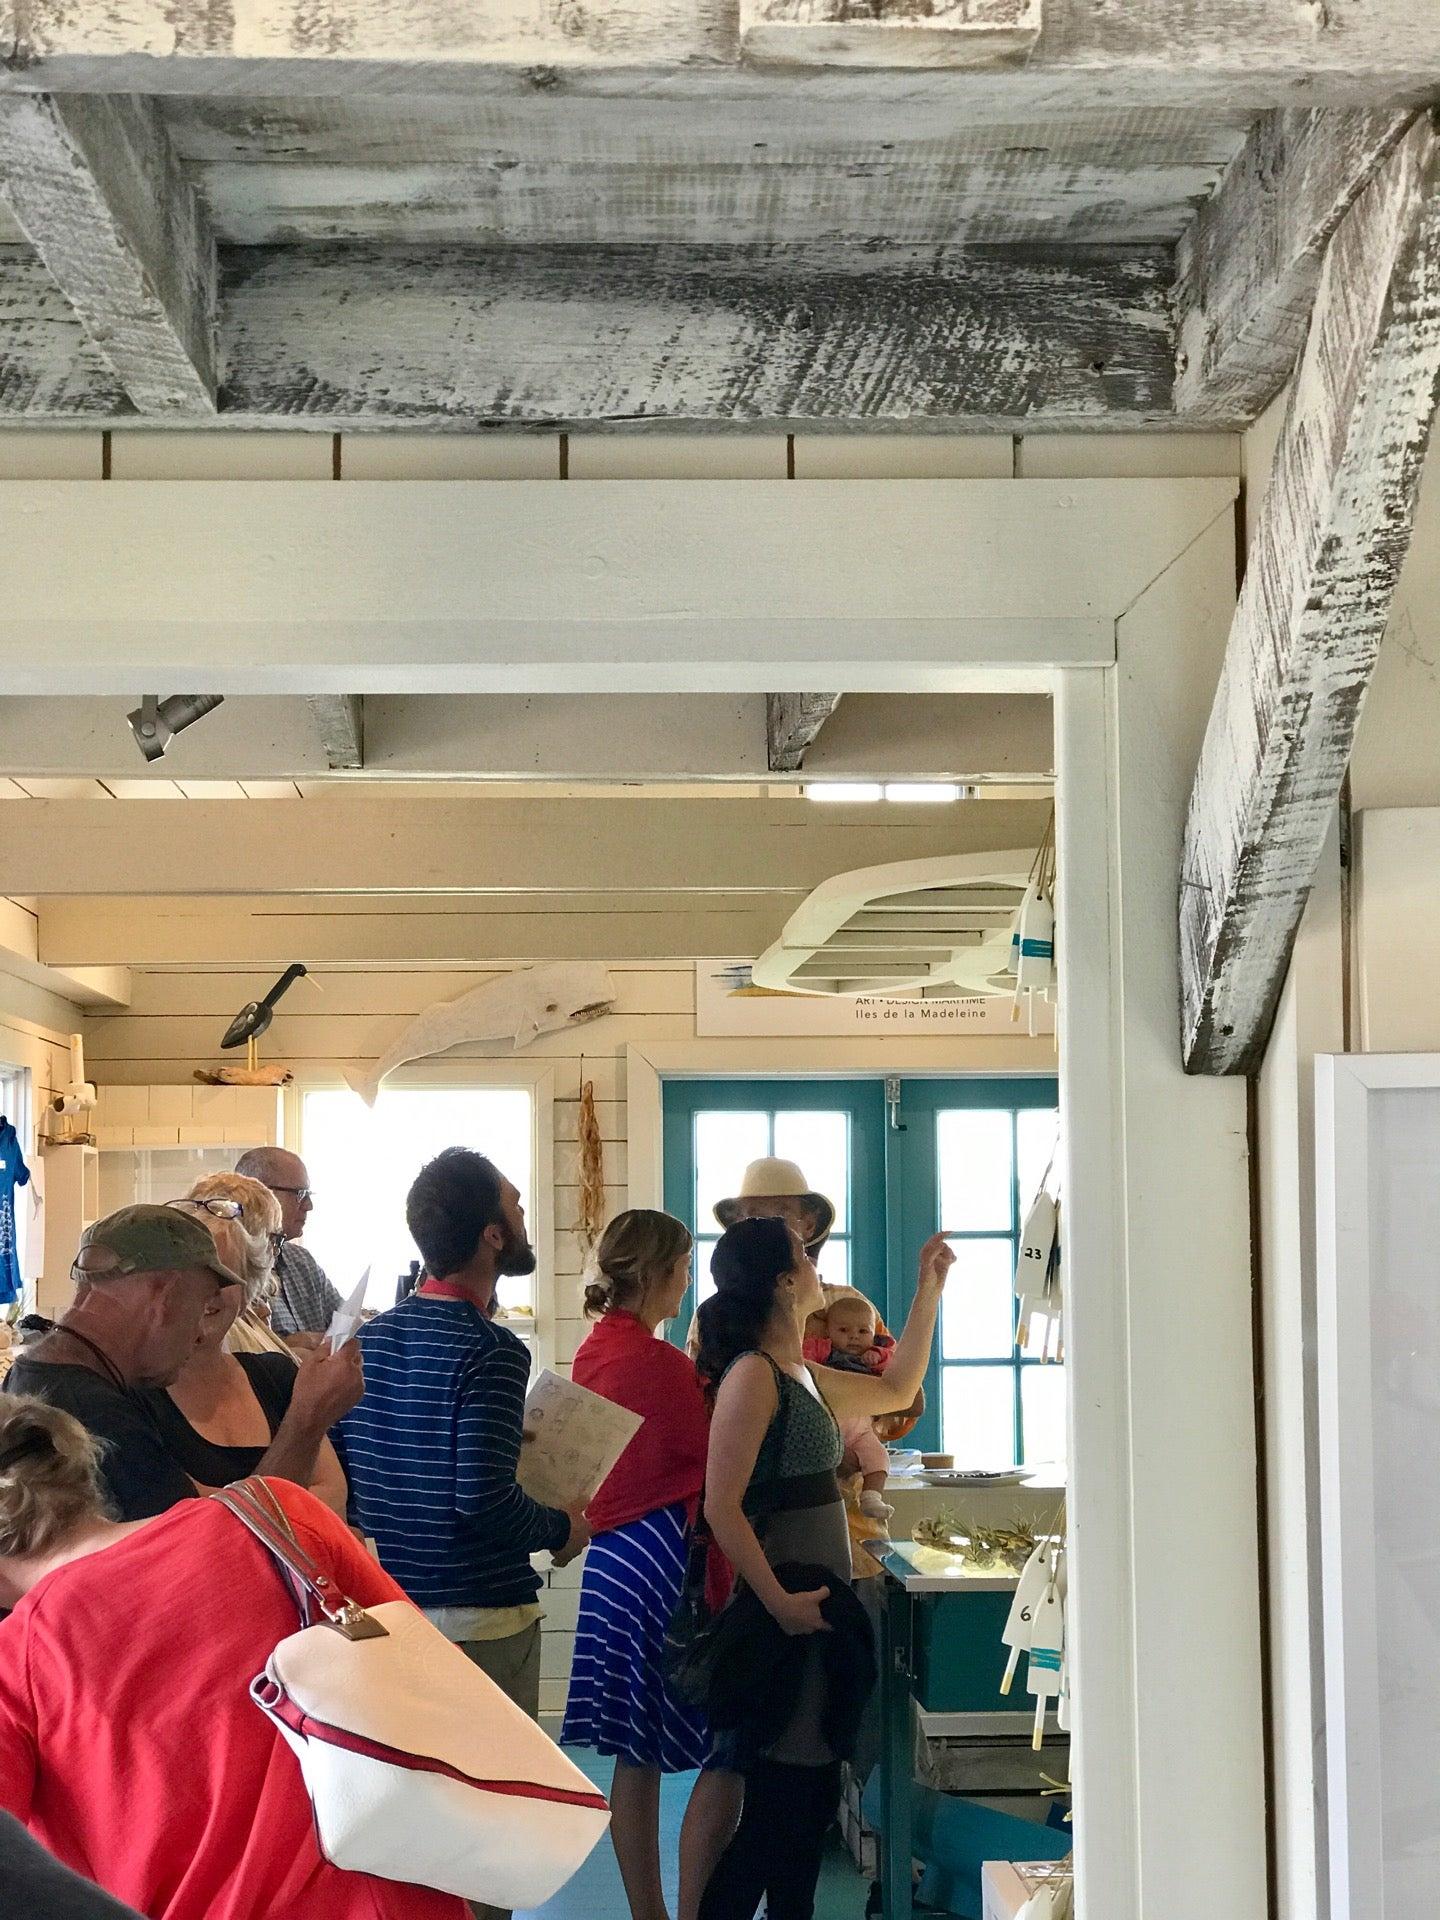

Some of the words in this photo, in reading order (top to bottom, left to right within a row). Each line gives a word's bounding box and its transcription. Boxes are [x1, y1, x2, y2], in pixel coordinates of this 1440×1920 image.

[855, 1009, 877, 1019] Iles
[883, 1009, 898, 1018] de
[904, 1009, 915, 1018] la
[921, 1008, 986, 1018] Madeleine
[1024, 1247, 1042, 1260] 23
[1020, 1605, 1032, 1622] 6
